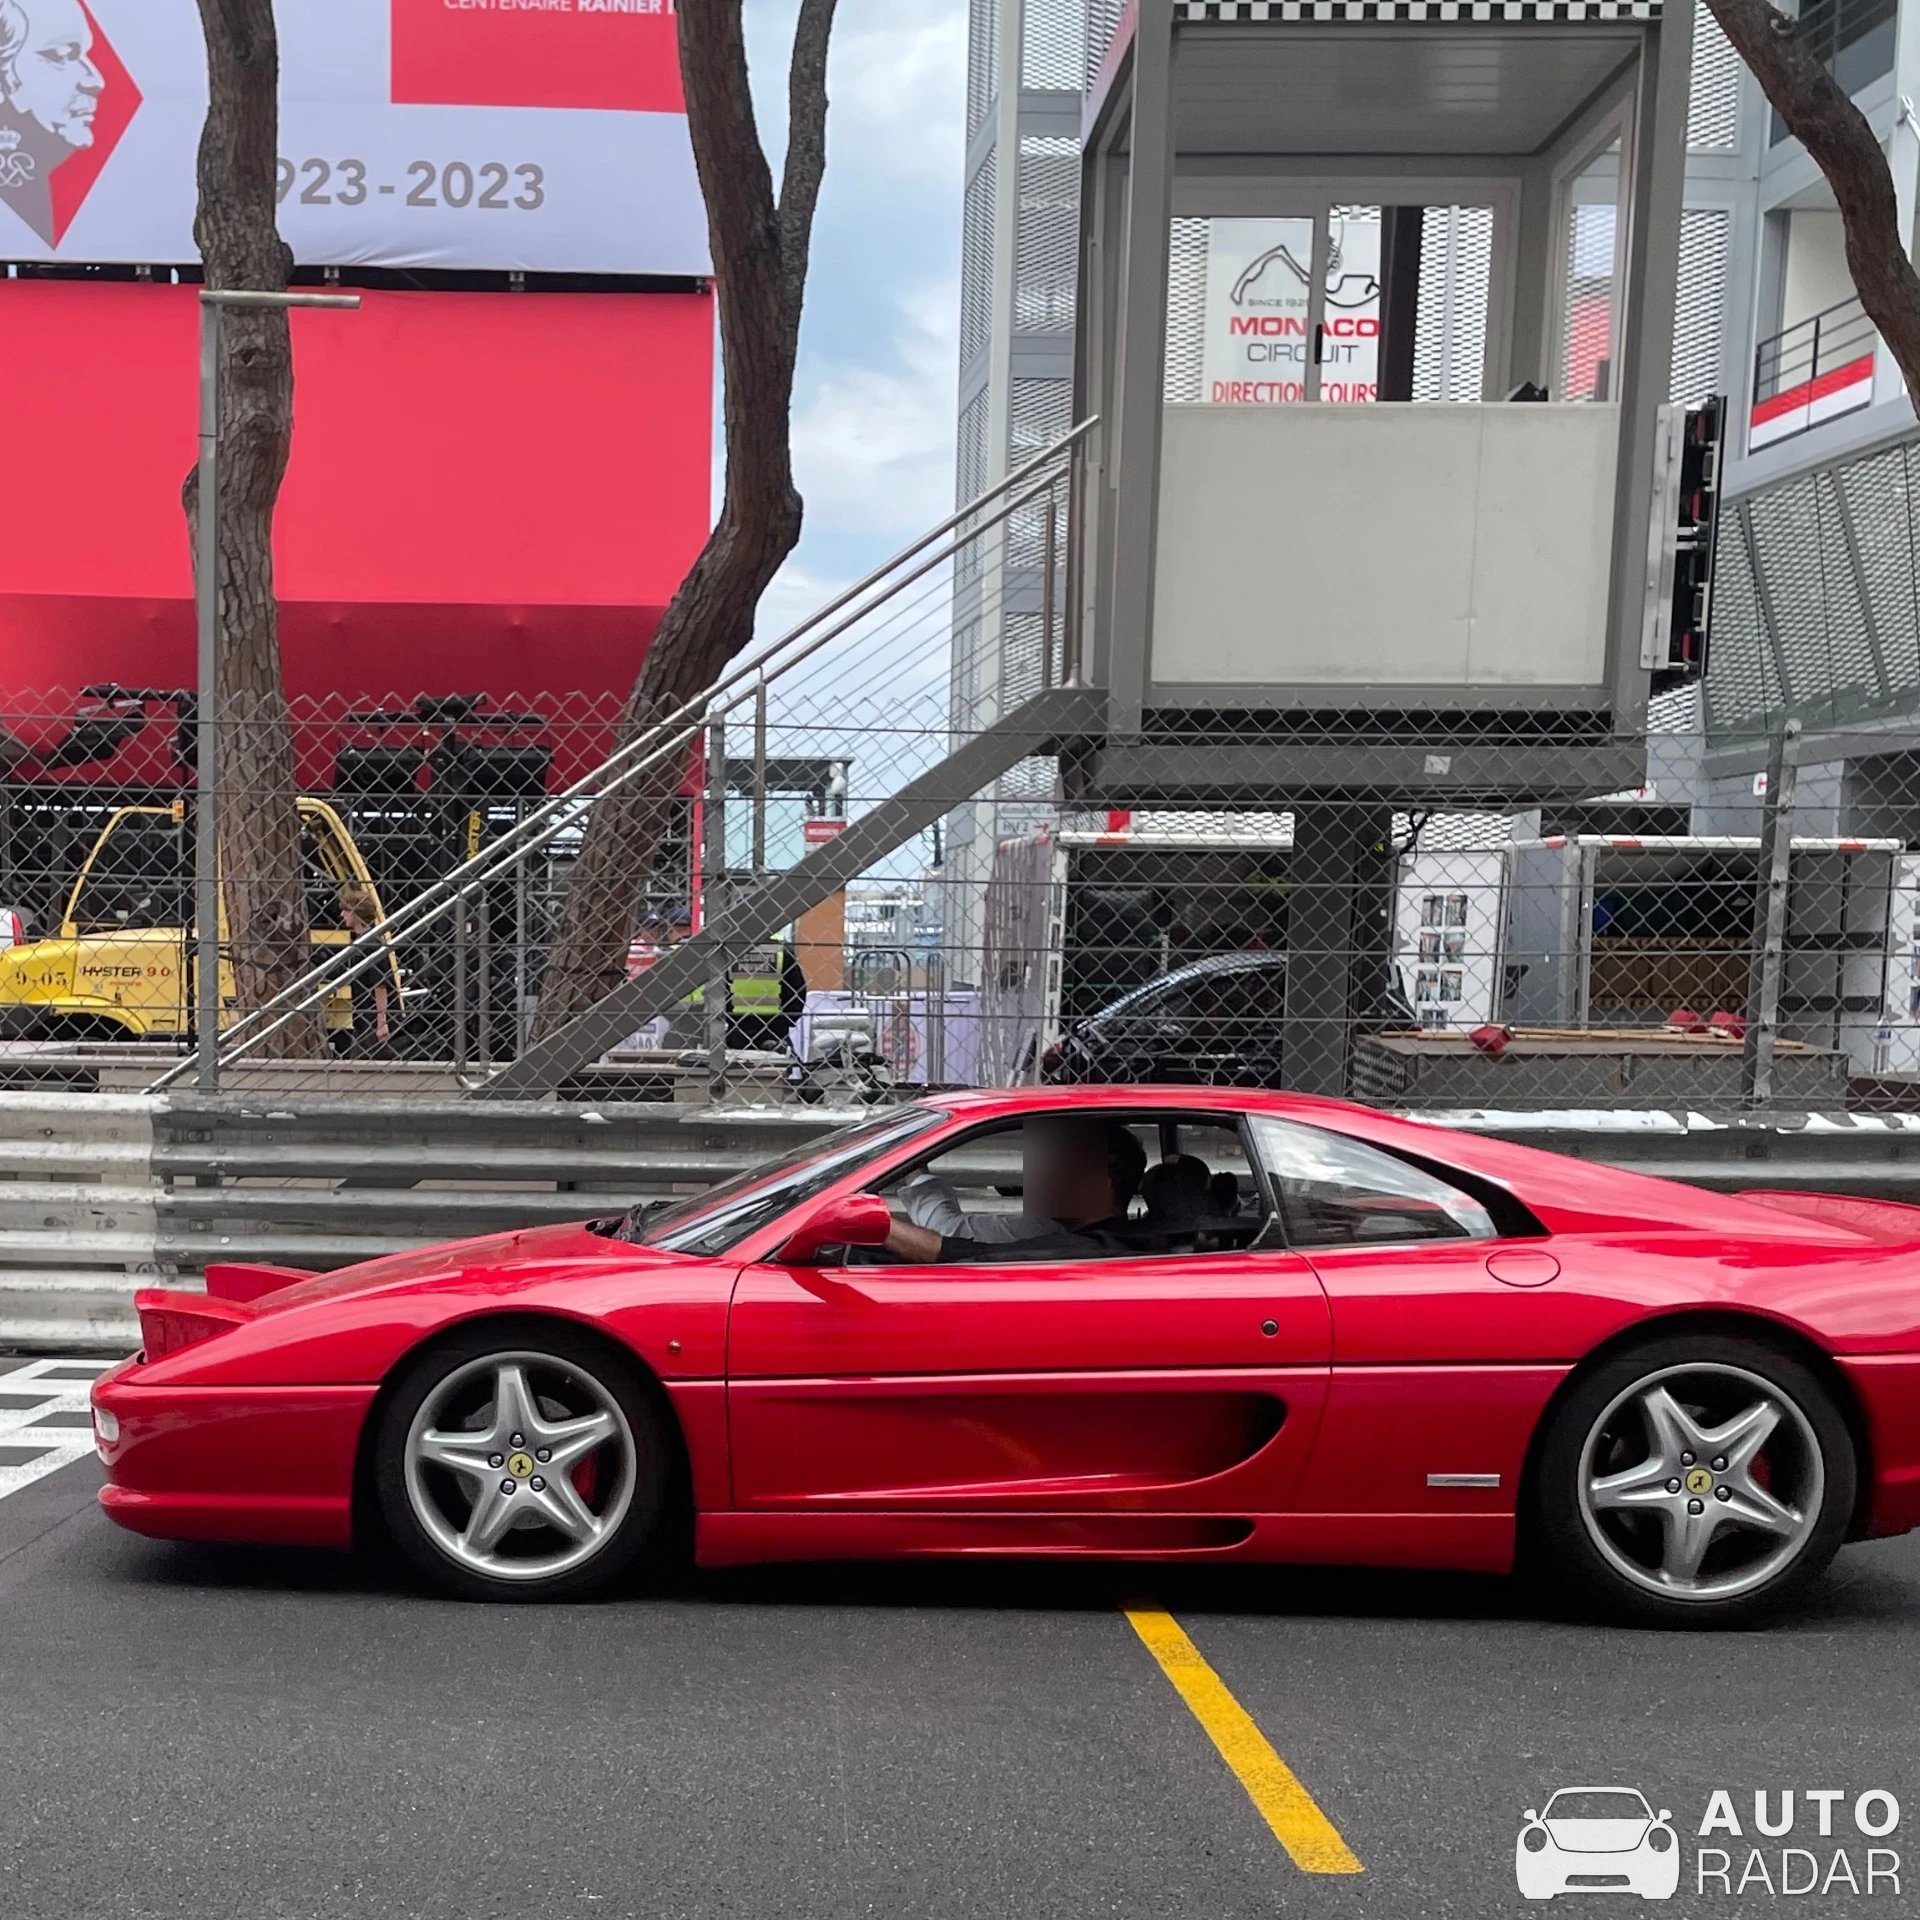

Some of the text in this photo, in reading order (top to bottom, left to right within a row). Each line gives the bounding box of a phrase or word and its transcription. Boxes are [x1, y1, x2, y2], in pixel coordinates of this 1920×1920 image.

[443, 0, 572, 11] CENTENAIRE
[578, 0, 661, 14] RAINIER
[276, 158, 367, 206] 923
[1248, 298, 1308, 307] SINCE 192
[82, 966, 141, 977] HYSTER
